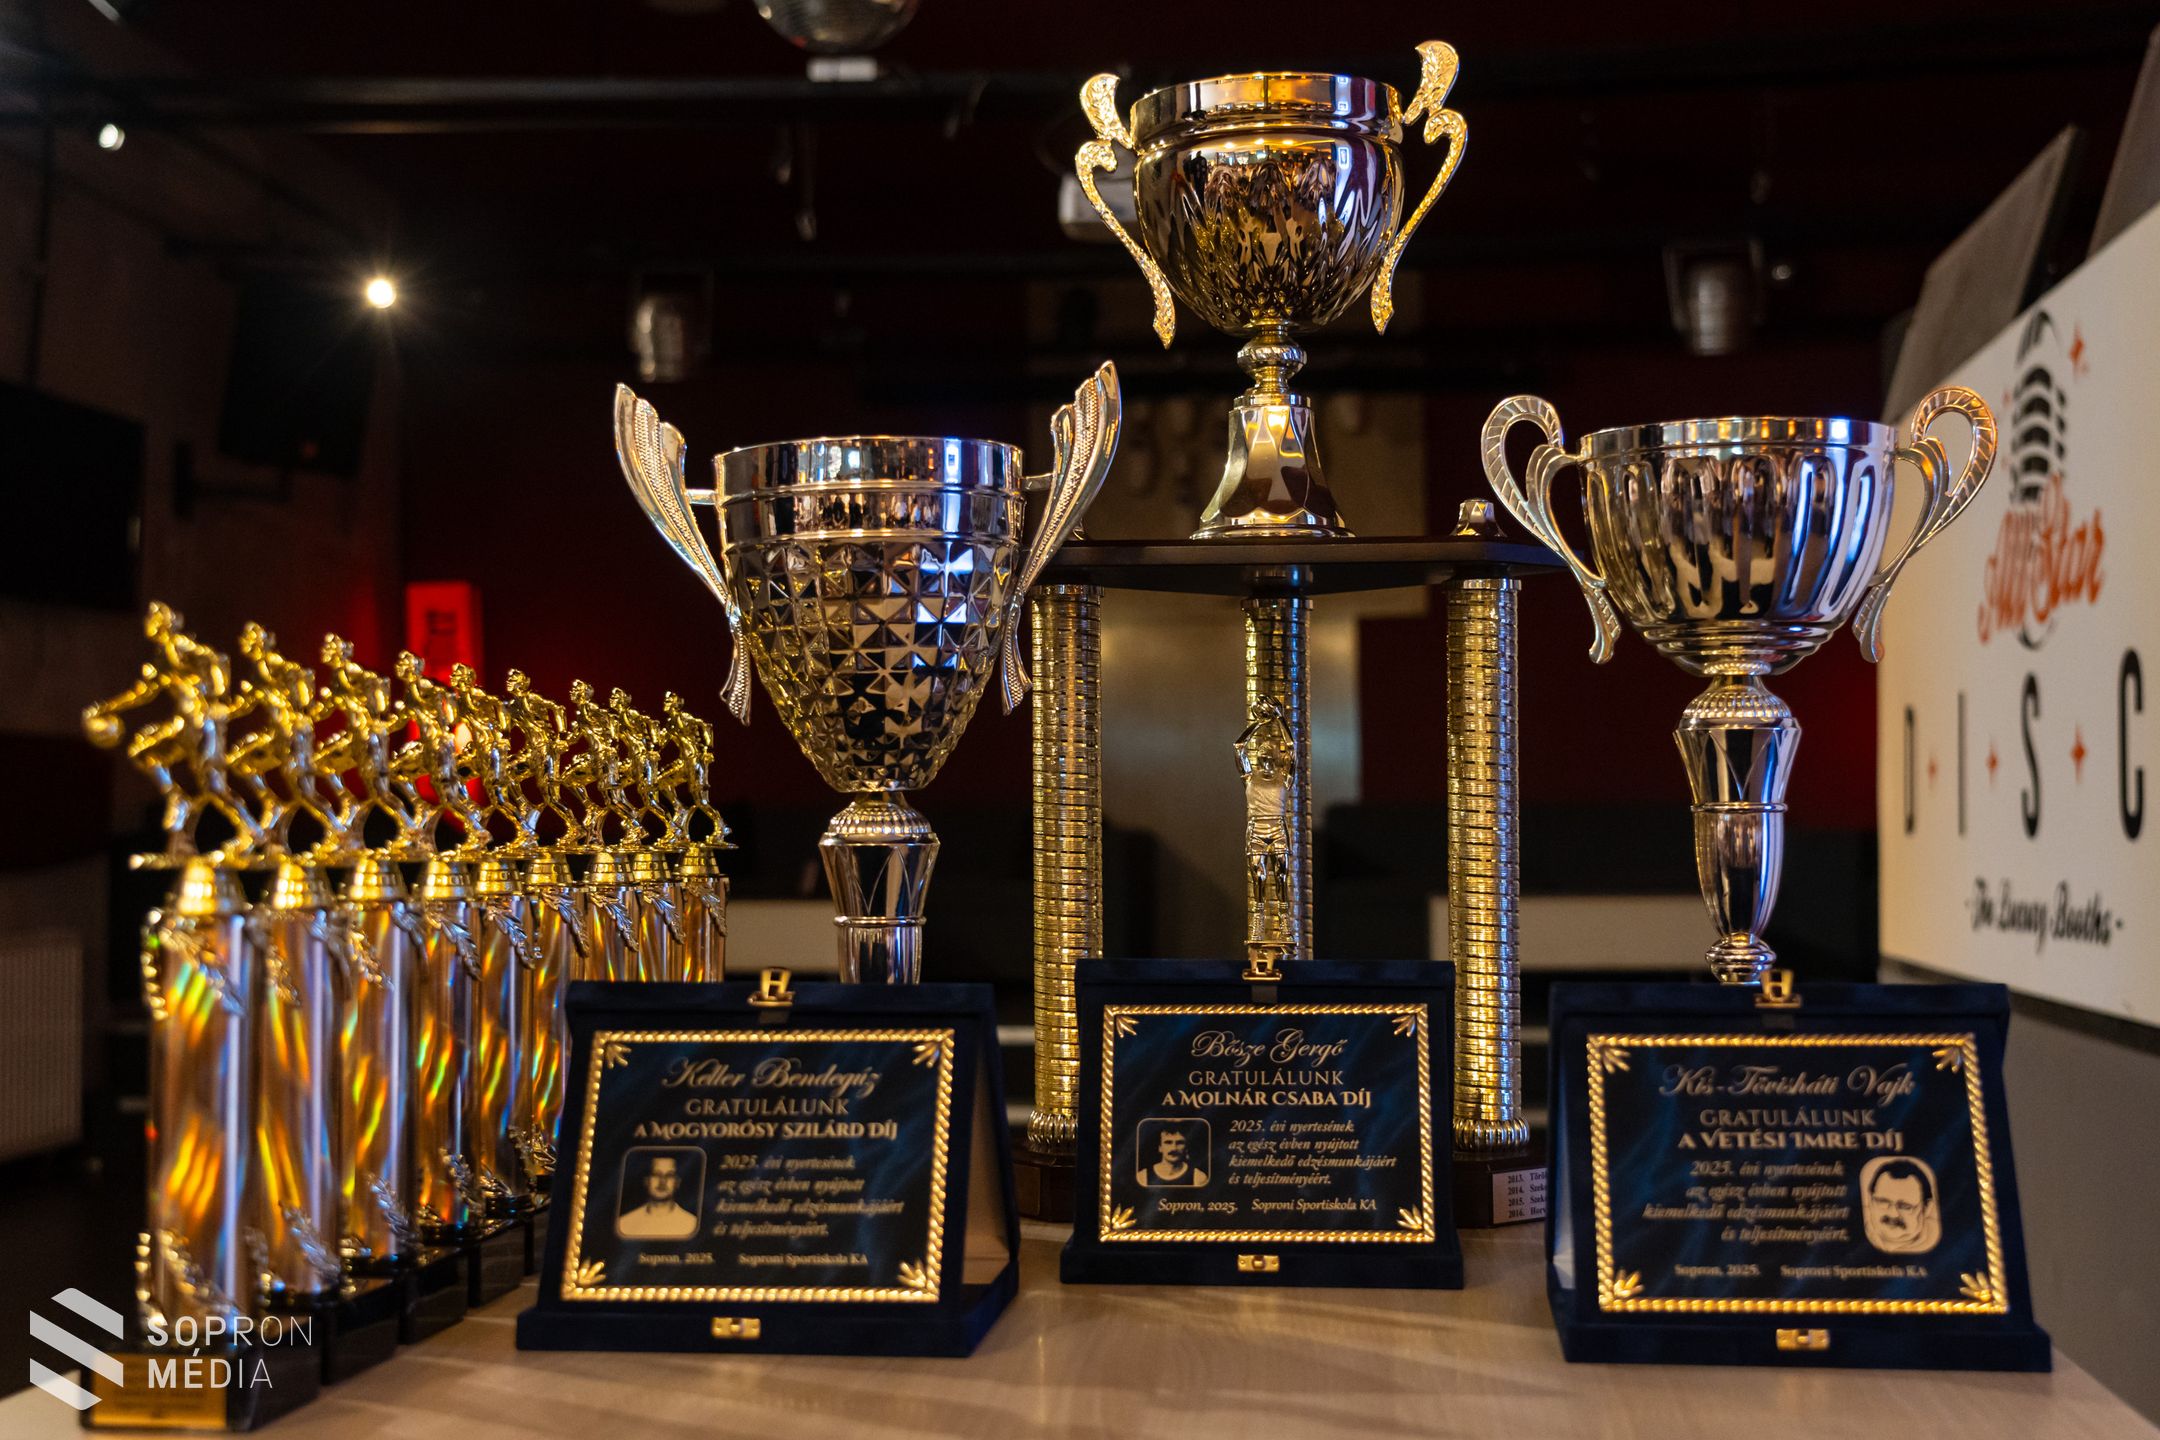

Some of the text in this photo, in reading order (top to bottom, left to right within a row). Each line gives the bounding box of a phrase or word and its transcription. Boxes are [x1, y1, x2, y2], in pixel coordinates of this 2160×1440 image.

[1191, 1028, 1348, 1068] Bősze Gergő
[661, 1056, 883, 1099] Keller Bendegúz
[1188, 1067, 1344, 1087] GRATULÁLUNK
[1846, 1063, 1916, 1108] Vajk
[684, 1096, 850, 1116] GRATULÁLUNK
[1161, 1087, 1373, 1108] A MOLNÁR CSABA DÍJ
[1700, 1105, 1877, 1128] GRATULÁLUNK
[633, 1118, 899, 1141] A MOGYORÓSY SZILÁRD DÍJ
[1229, 1119, 1355, 1135] 2025. évi nyertesének
[1228, 1138, 1360, 1154] az egész évben nyújtott
[1677, 1127, 1905, 1151] A VETÉSI IMRE DÍJ
[1228, 1154, 1398, 1171] kiemelkedő edzésmunkájáért
[1228, 1172, 1332, 1188] és teljesítményéért.
[1157, 1198, 1377, 1214] Sopron, 2025. Soproni Sportiskola KA
